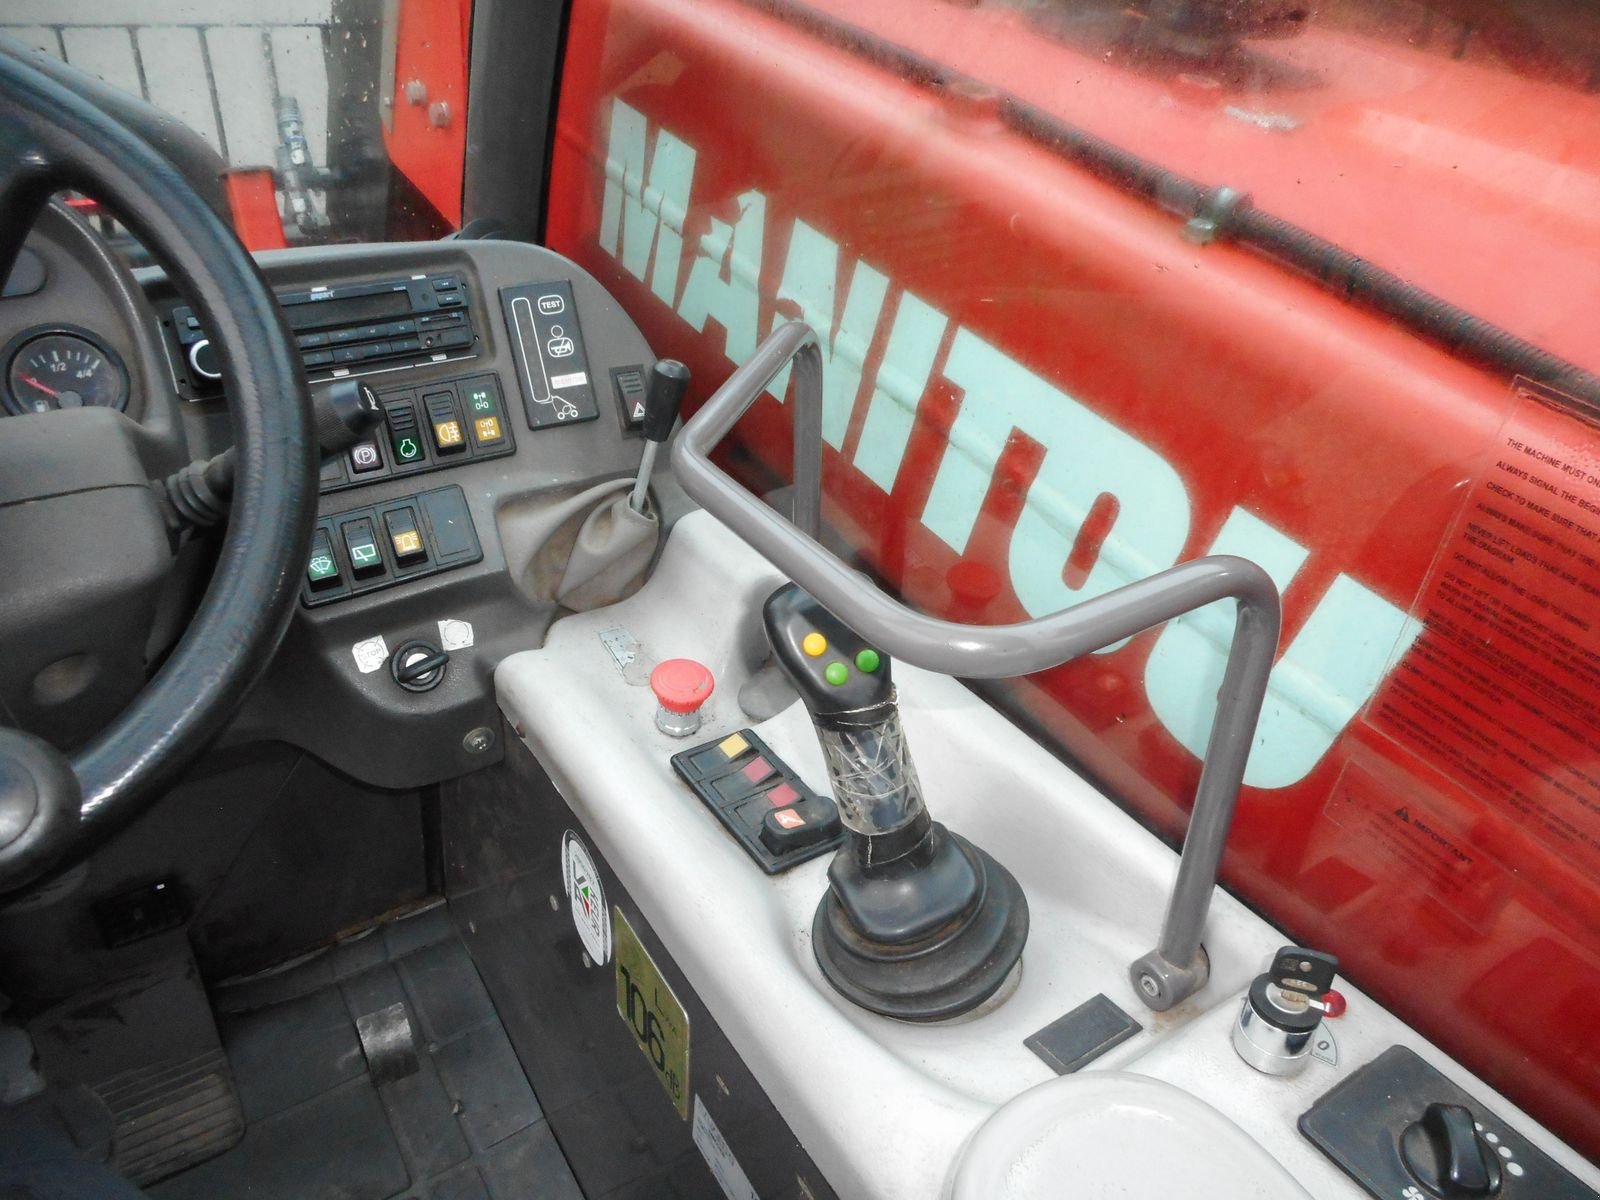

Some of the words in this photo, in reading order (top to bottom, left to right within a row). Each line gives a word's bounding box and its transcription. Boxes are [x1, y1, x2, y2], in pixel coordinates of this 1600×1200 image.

[541, 299, 561, 309] TEST
[50, 362, 67, 373] 1/2
[75, 369, 93, 379] 4/4
[599, 97, 1422, 790] MANITOU
[1507, 438, 1522, 450] THE
[1524, 445, 1561, 469] MACHINE
[1562, 463, 1586, 480] MUST
[1587, 475, 1600, 487] ON
[1496, 460, 1528, 480] ALWAYS
[1529, 475, 1559, 495] SIGNAL
[1560, 490, 1577, 503] THE
[1476, 502, 1507, 521] ALWAYS
[1486, 481, 1514, 499] CHECK
[1513, 494, 1526, 505] TO
[1527, 501, 1550, 517] MAKE
[1551, 513, 1574, 529] SURE
[1576, 525, 1598, 540] THAT
[1465, 558, 1481, 571] NOT
[1467, 522, 1492, 539] NEVER
[1493, 536, 1510, 549] LIFT
[1510, 545, 1537, 563] LOADS
[1539, 560, 1559, 574] THAT
[1413, 819, 1473, 865] IMPORTANT
[620, 964, 665, 1072] 106
